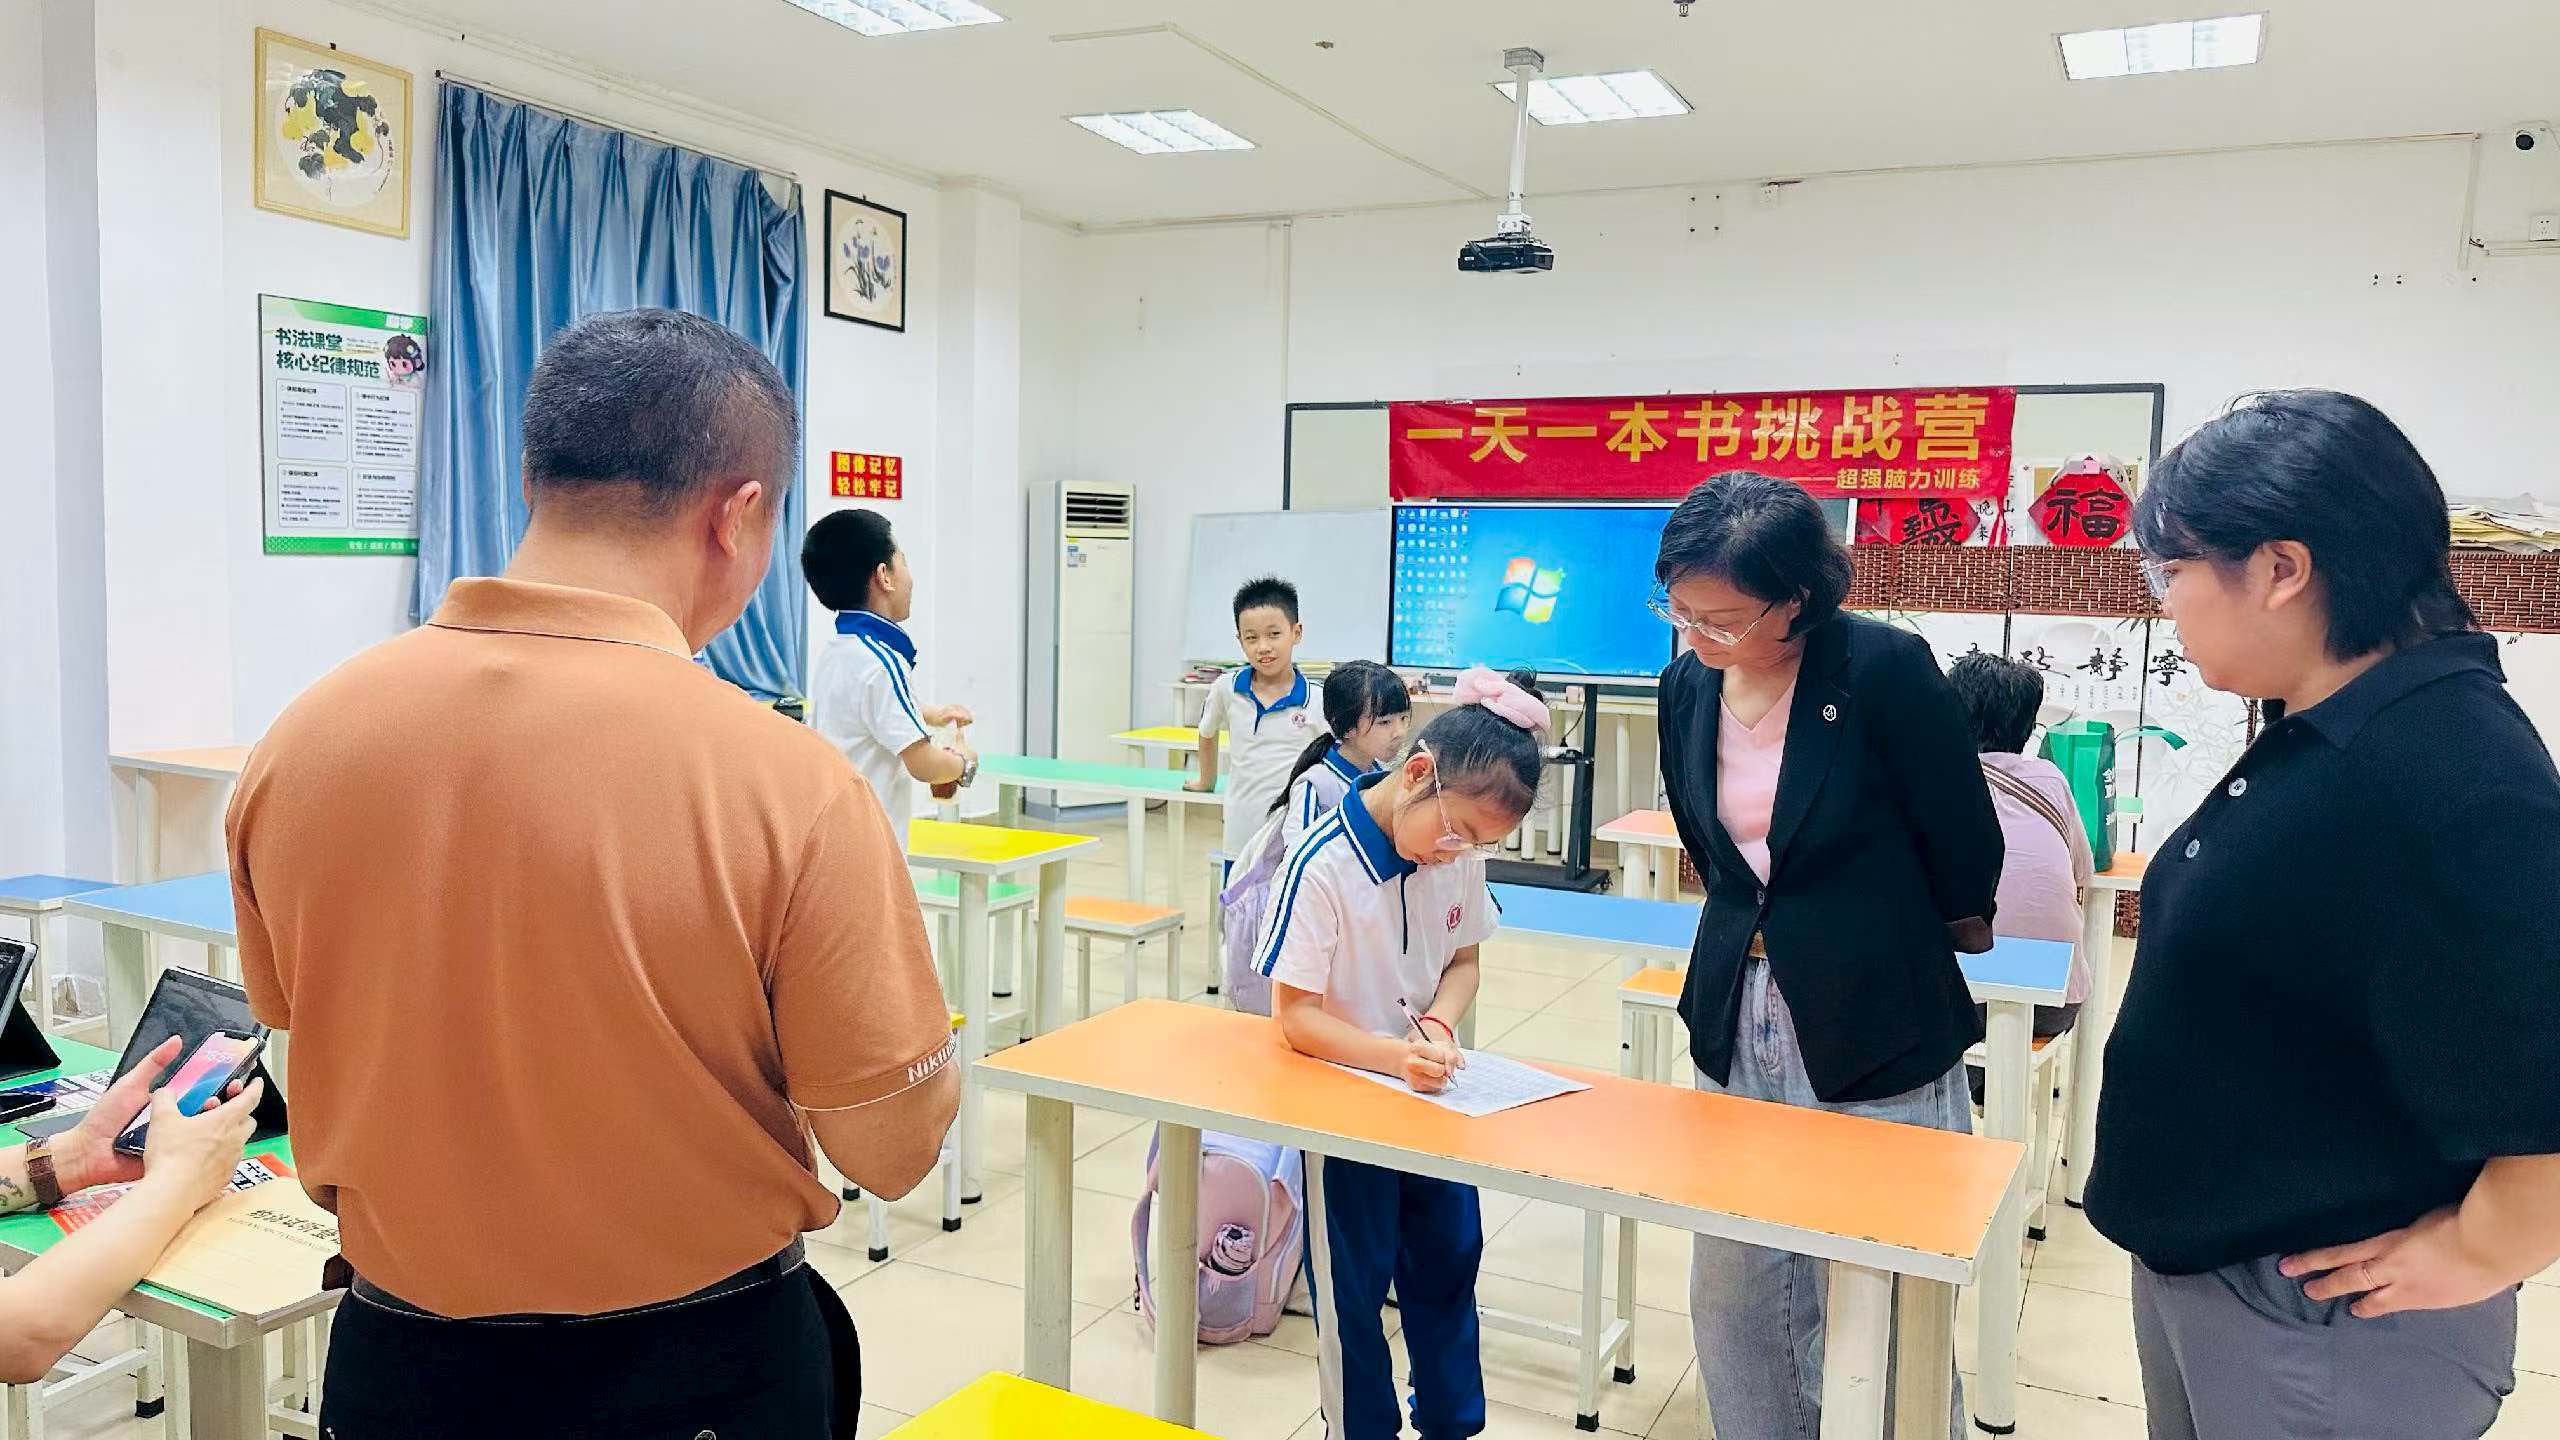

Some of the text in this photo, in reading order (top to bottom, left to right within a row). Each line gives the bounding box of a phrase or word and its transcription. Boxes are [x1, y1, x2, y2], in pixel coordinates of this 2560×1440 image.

[275, 327, 343, 352] 书法课堂
[275, 349, 380, 379] 核心纪律规范
[1406, 395, 1990, 465] 一天一本书挑战营
[836, 453, 898, 477] 图像记忆
[836, 476, 898, 498] 轻松牢记
[2045, 487, 2124, 540] 福
